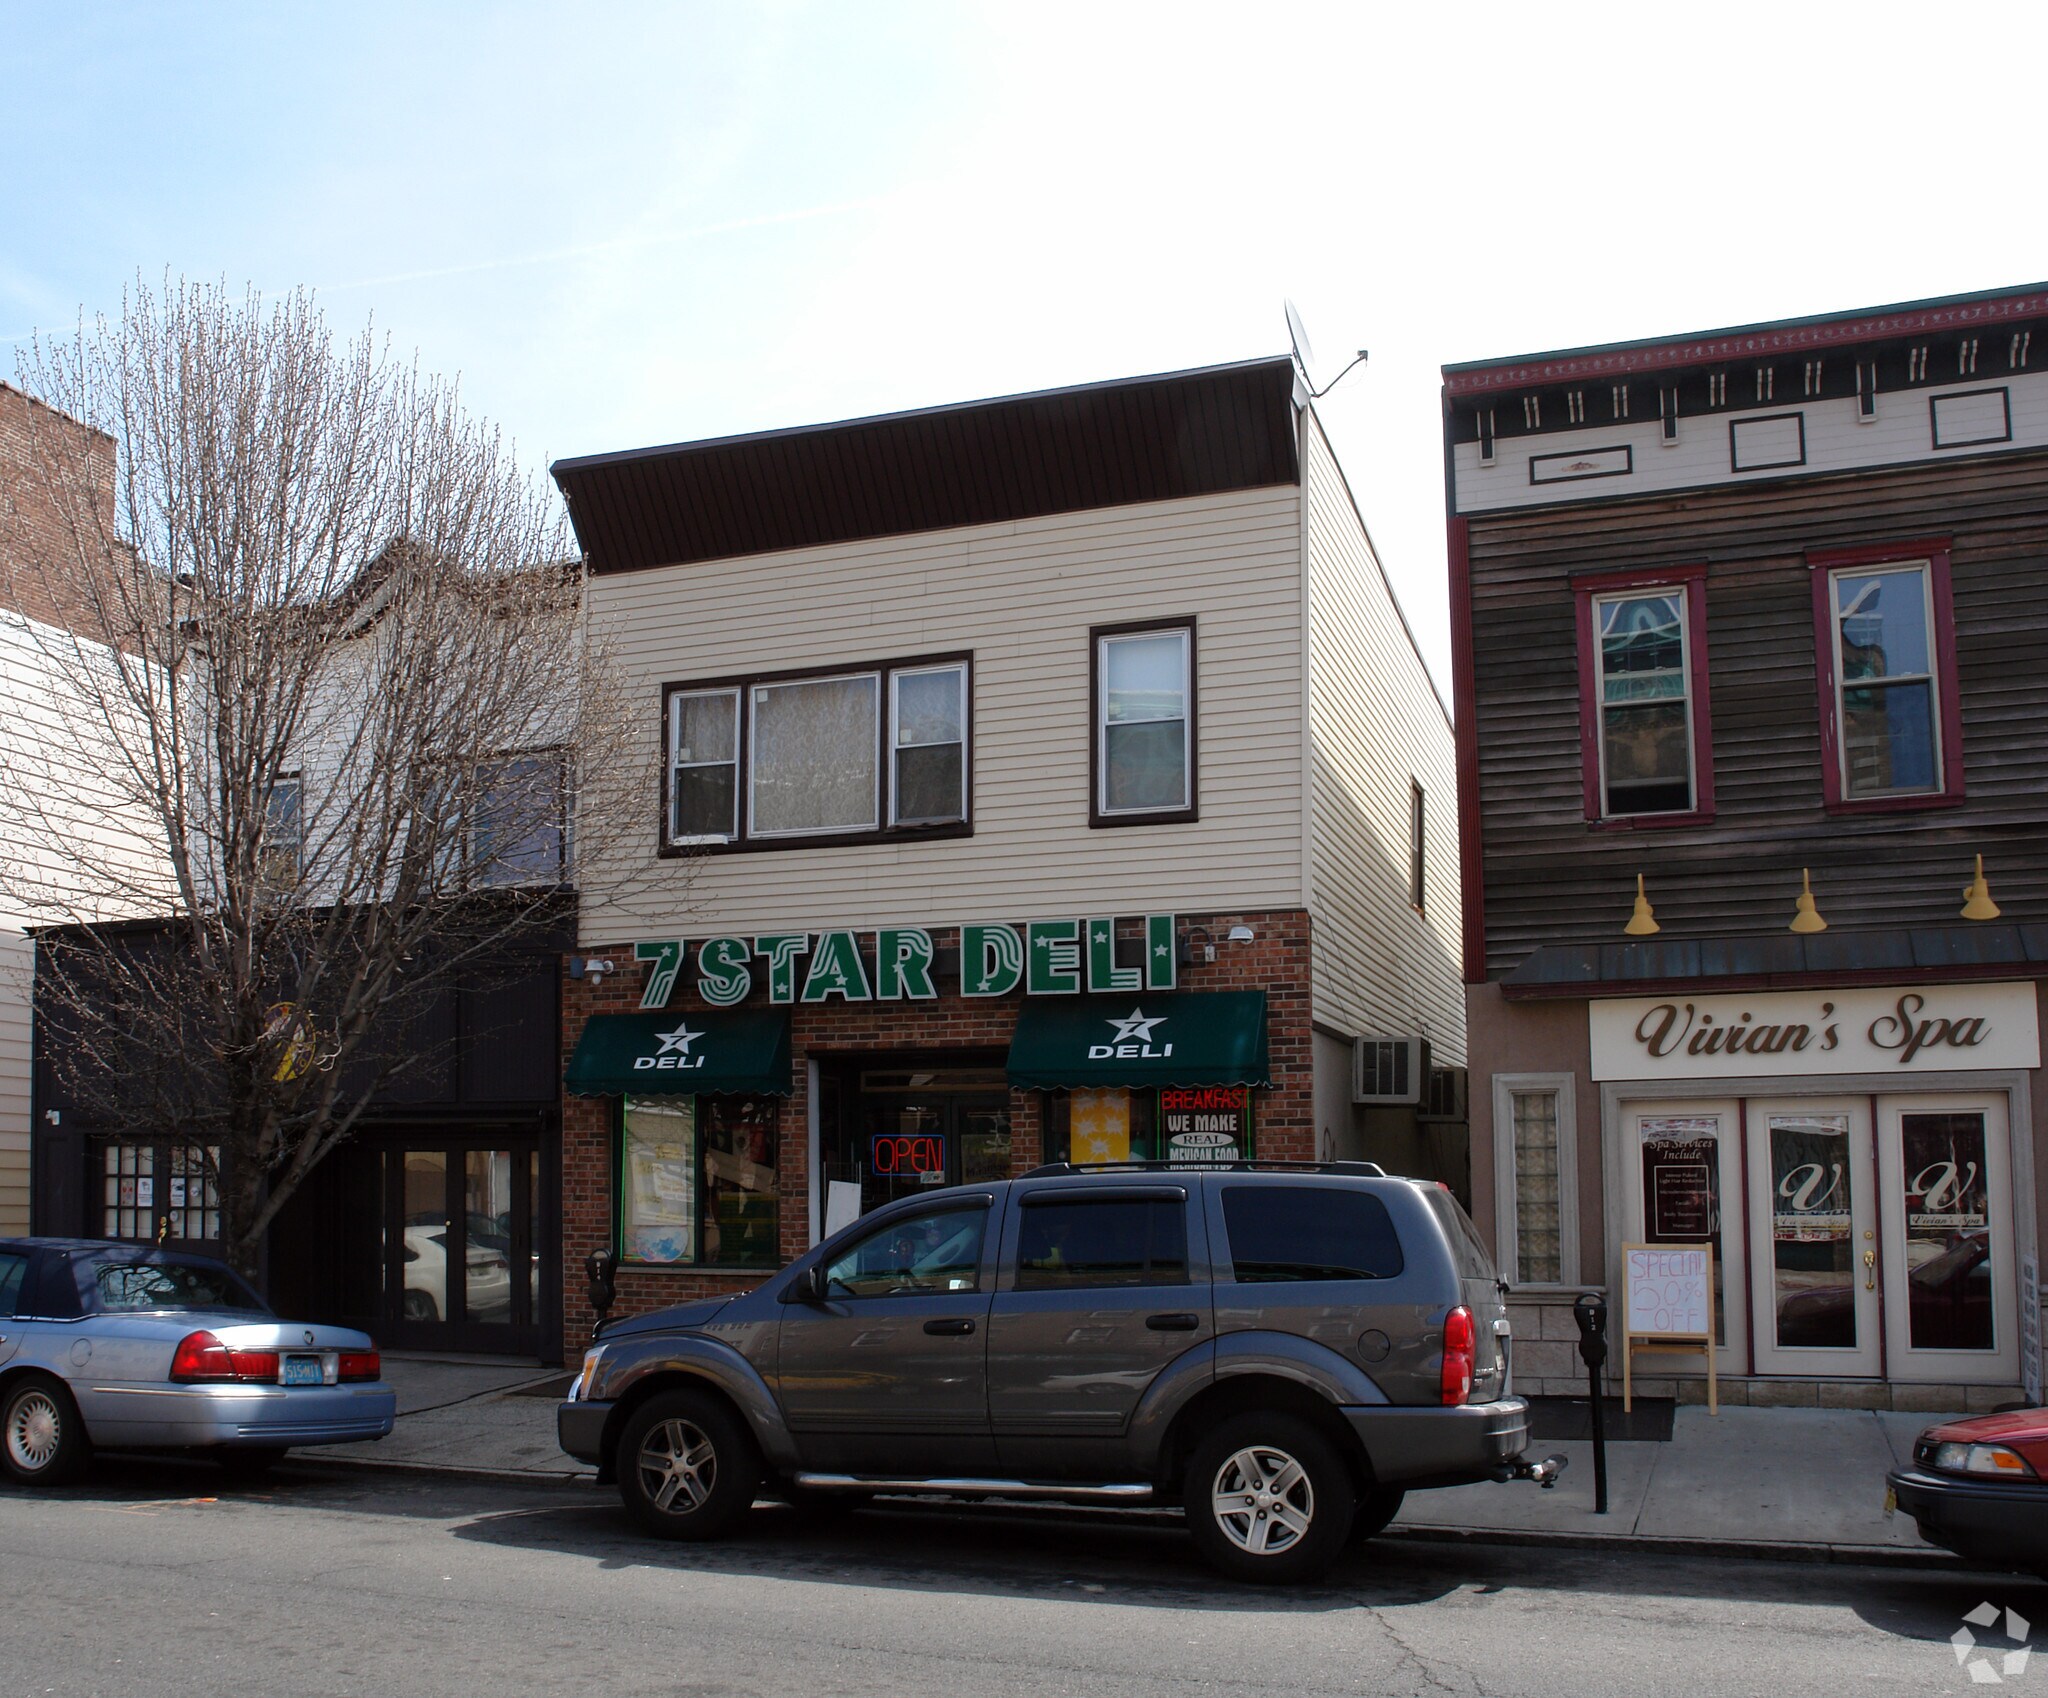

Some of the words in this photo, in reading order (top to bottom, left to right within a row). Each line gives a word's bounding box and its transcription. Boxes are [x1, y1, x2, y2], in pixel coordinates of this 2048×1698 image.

[634, 938, 684, 1009] 7
[697, 927, 938, 1006] STAR
[960, 913, 1176, 998] DELI
[1124, 1021, 1147, 1033] 7
[1635, 1002, 1839, 1058] Vivian's
[1867, 993, 1992, 1063] Spa
[669, 1035, 688, 1046] 7
[1088, 1043, 1173, 1059] DELI
[633, 1055, 705, 1070] DELI
[1161, 1088, 1249, 1110] BREAKFAST
[1167, 1115, 1190, 1132] WE
[1195, 1114, 1238, 1131] MAKE
[1183, 1135, 1223, 1145] REAL
[1650, 1140, 1669, 1151] Spa
[1672, 1139, 1713, 1149] Services
[875, 1138, 943, 1173] OPEN
[1663, 1150, 1701, 1160] Include
[1779, 1163, 1842, 1210] V
[1911, 1161, 1977, 1209] V
[1631, 1252, 1708, 1279] SPECIAL
[1633, 1278, 1703, 1311] 50%
[1655, 1308, 1699, 1332] OFF
